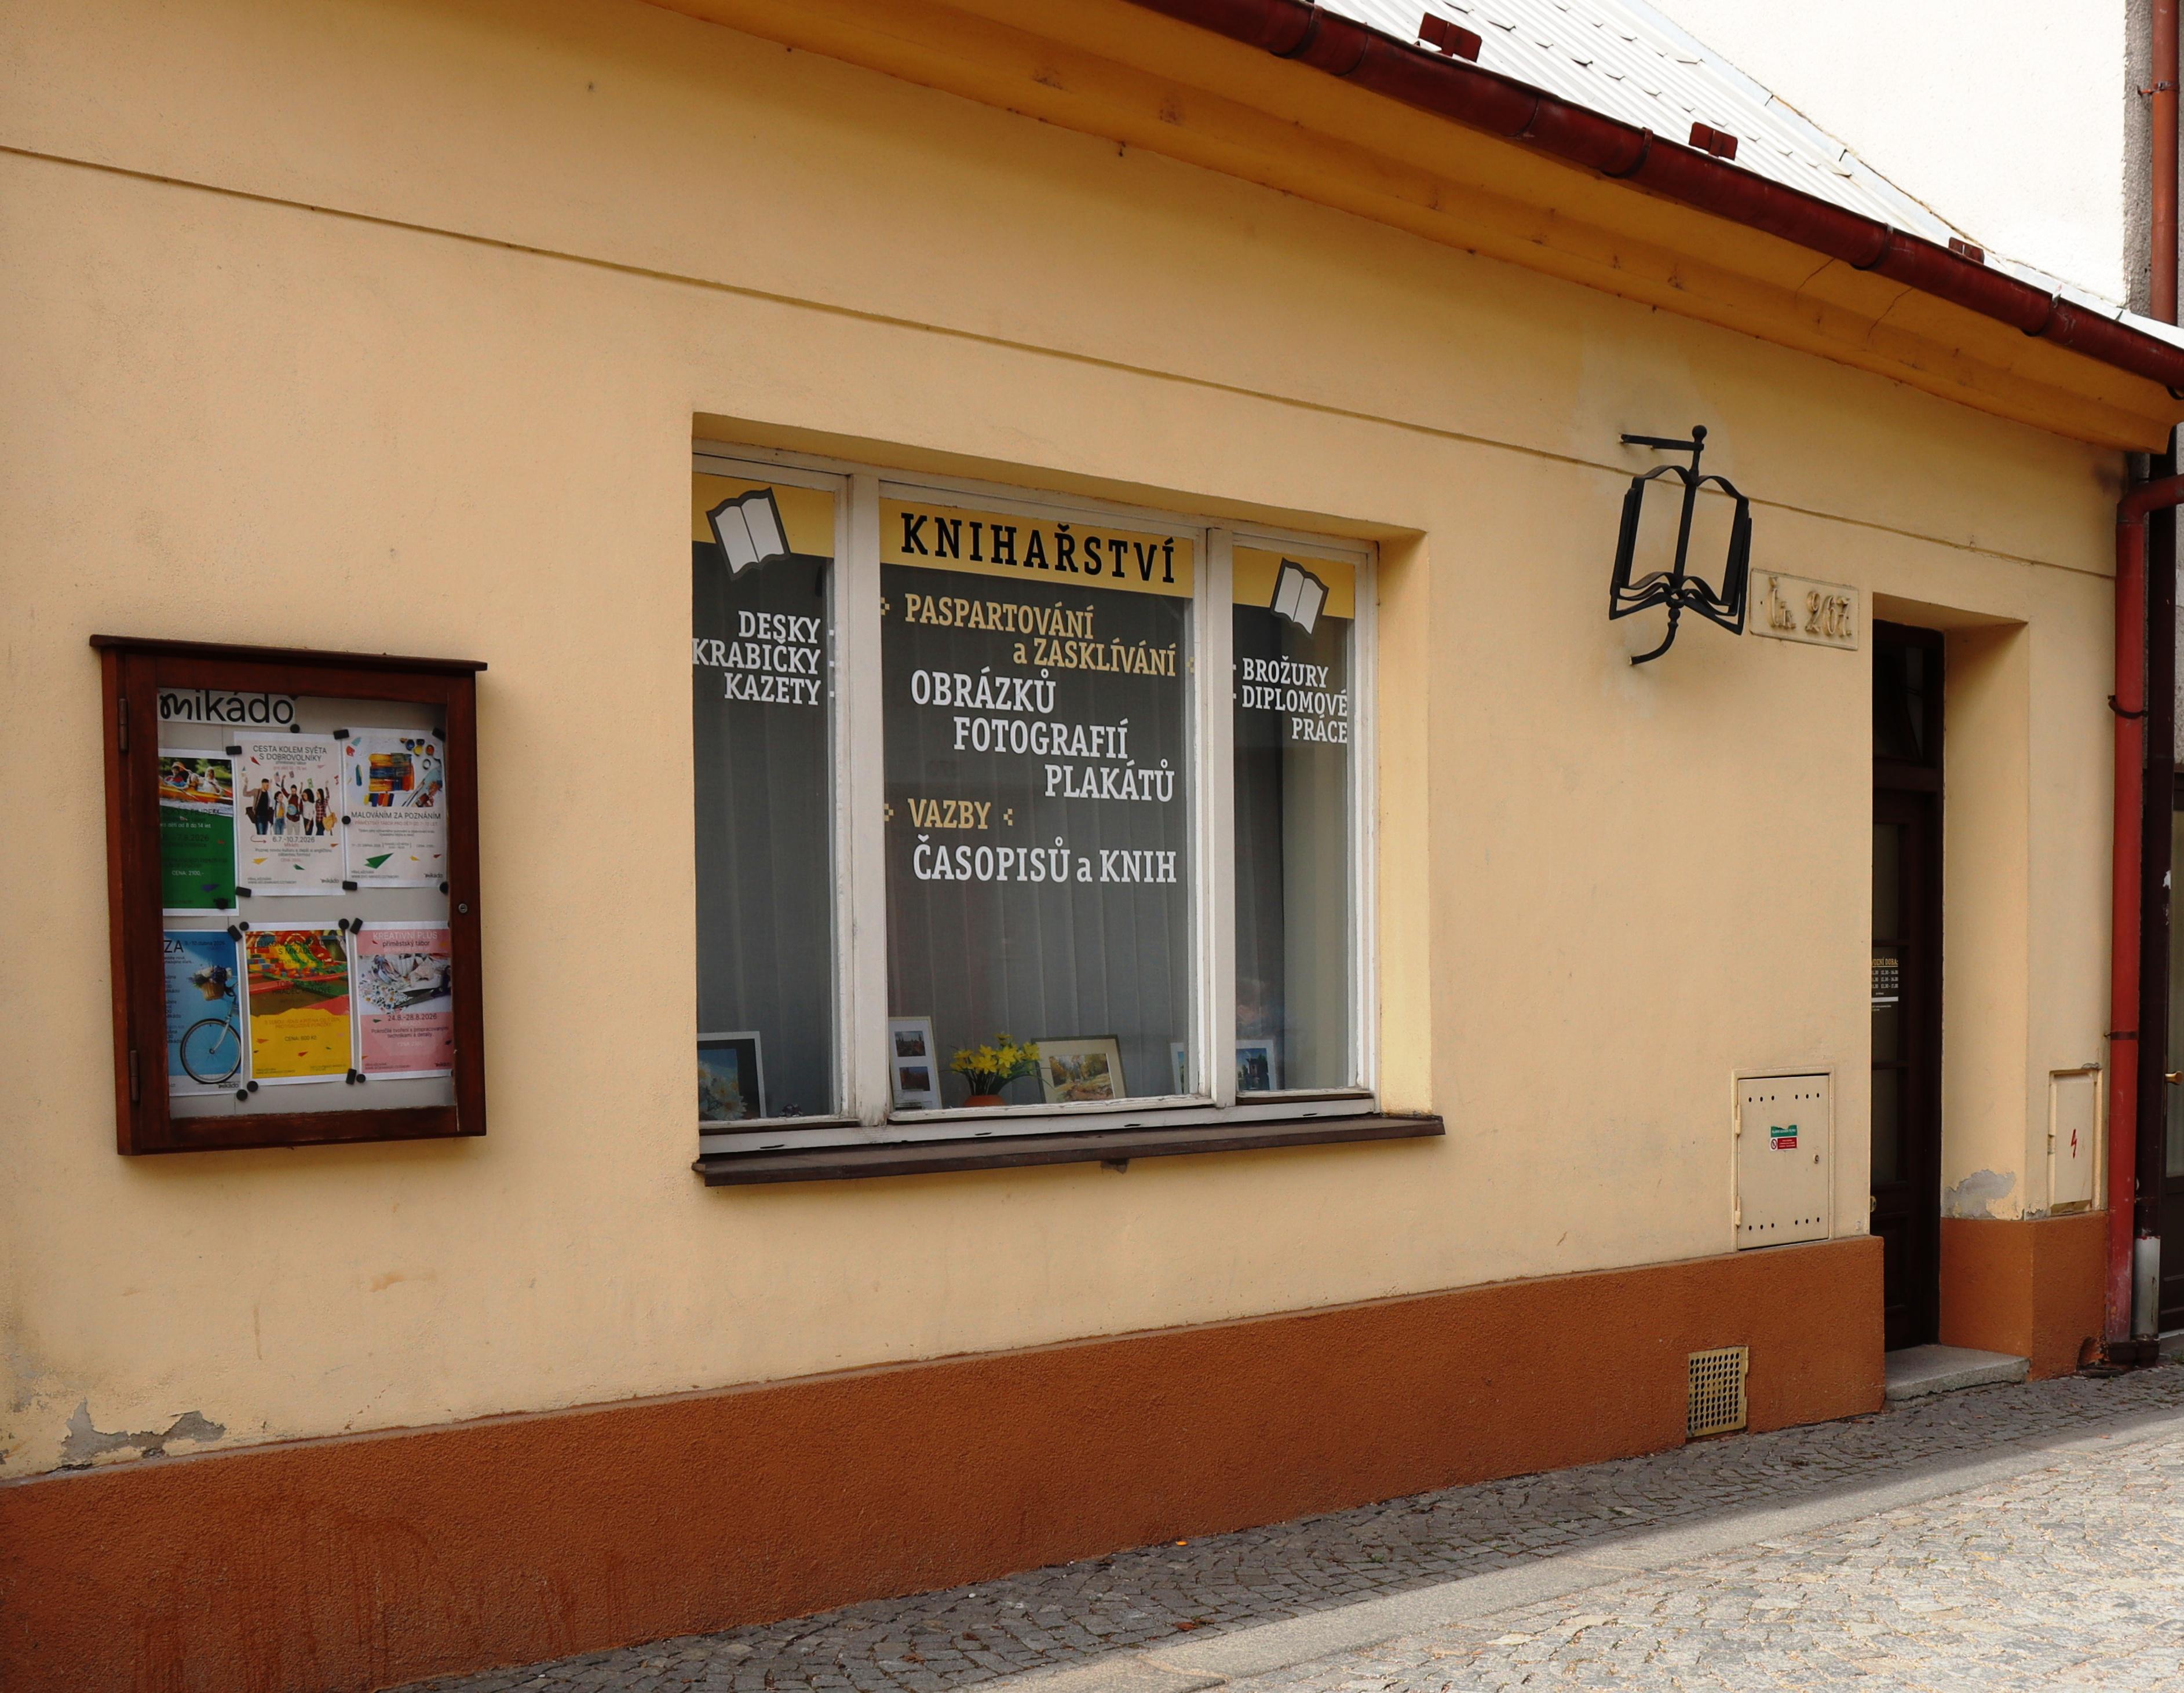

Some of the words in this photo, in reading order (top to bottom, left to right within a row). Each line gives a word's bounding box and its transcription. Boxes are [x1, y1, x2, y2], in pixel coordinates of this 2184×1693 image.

[901, 512, 1175, 583] KNIHAŘSTVÍ
[738, 610, 820, 644] DESKY
[905, 593, 1094, 639] PASPARTOVÁNÍ
[693, 638, 820, 675] KRABIČKY
[1013, 642, 1027, 664] a
[1034, 638, 1176, 677] ZASKLÍVÁNÍ
[1242, 655, 1329, 688] BROŽURY
[724, 672, 821, 706] KAZETY
[911, 666, 1056, 713] OBRÁZKŮ
[1242, 685, 1347, 717] DIPLOMOVÉ
[954, 718, 1129, 759] FOTOGRAFIÍ
[1291, 714, 1347, 744] PRÁCE
[305, 745, 327, 754] SVĚTA
[1045, 759, 1175, 802] PLAKÁTŮ
[405, 811, 441, 820] POZNÁNÍM
[907, 798, 991, 829] VAZBY
[914, 834, 1071, 883] ČASOPISŮ
[1077, 857, 1093, 882] a
[1100, 850, 1177, 883] KNIH
[372, 931, 415, 940] KREATIVNÍ
[417, 931, 437, 939] PLUS
